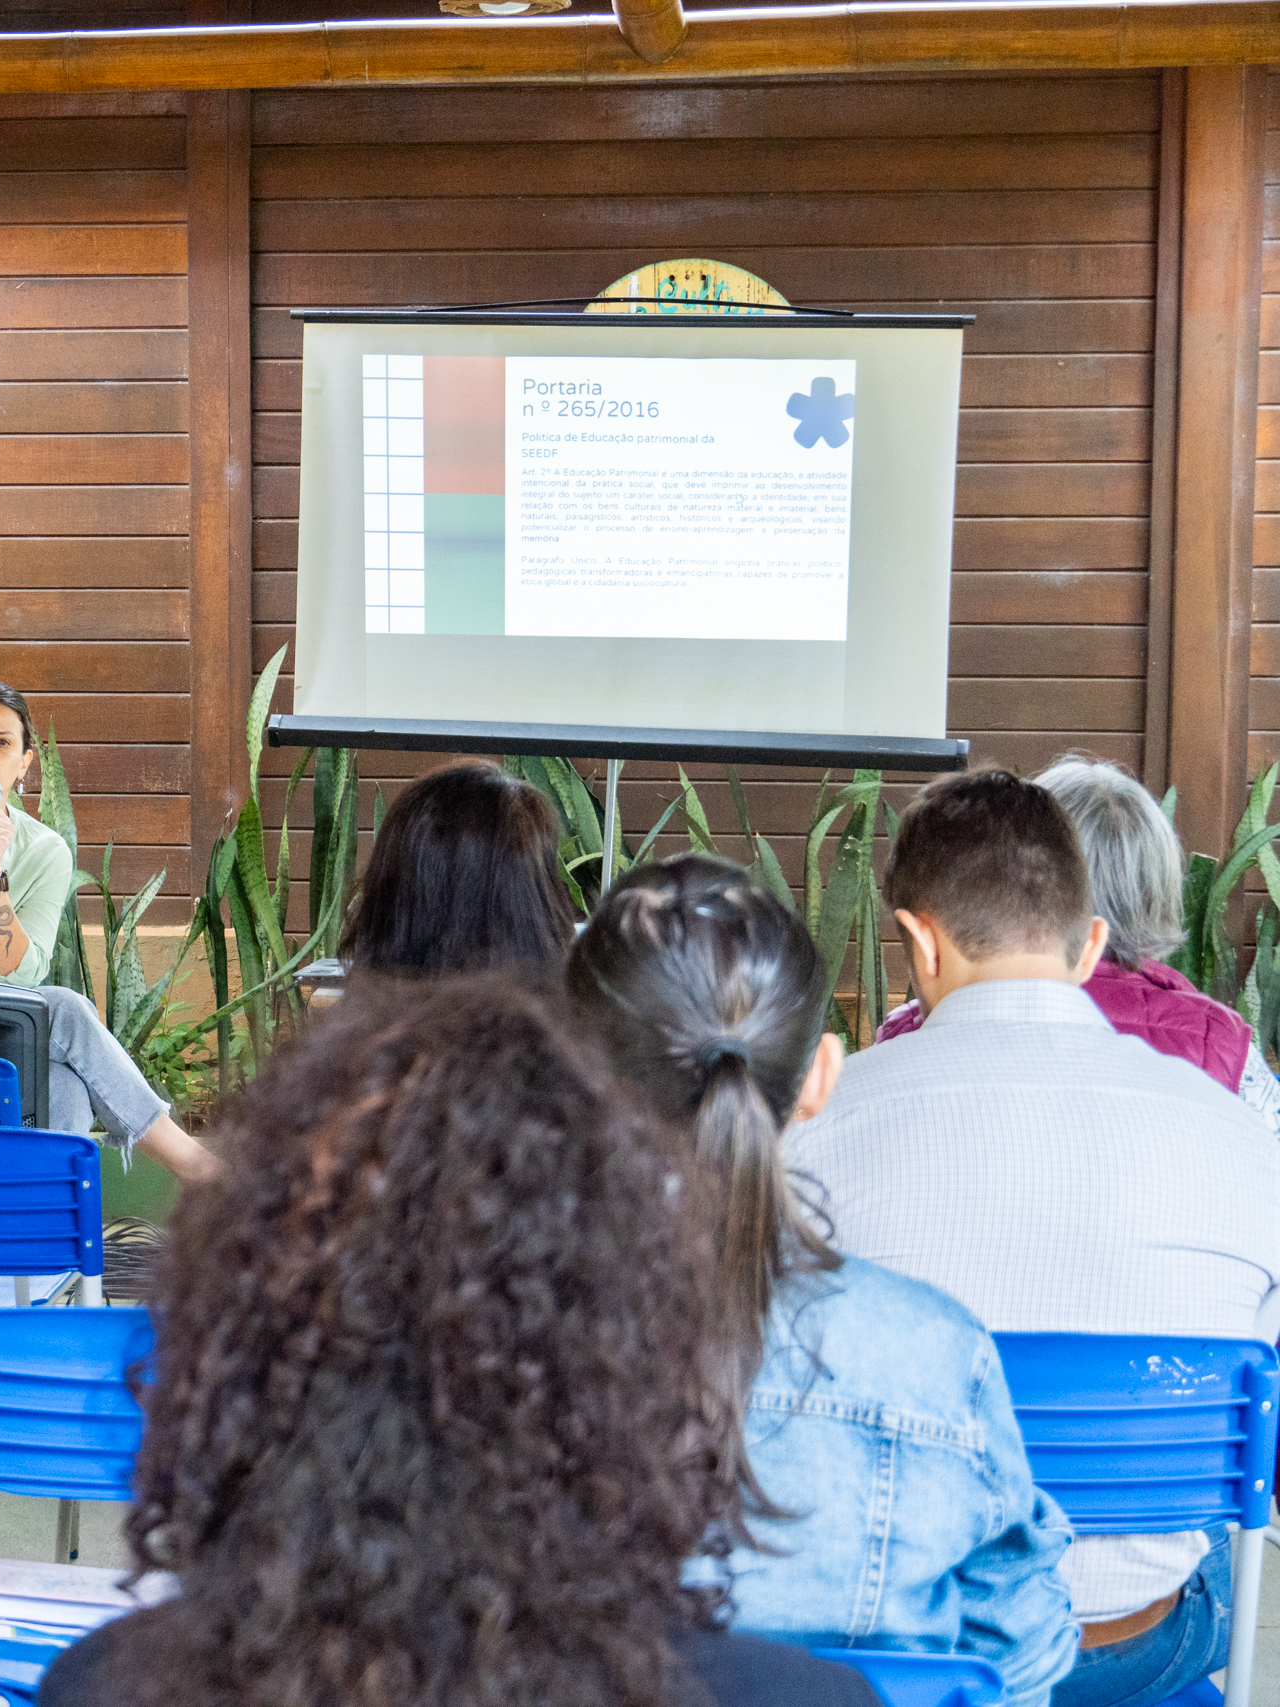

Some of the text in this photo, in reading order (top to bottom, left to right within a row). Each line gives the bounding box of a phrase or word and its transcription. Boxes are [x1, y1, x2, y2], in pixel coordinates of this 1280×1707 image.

[523, 379, 602, 395] Portaria
[523, 404, 534, 416] n
[557, 400, 659, 418] 265/2016
[564, 433, 577, 442] de
[581, 433, 633, 444] Educação
[637, 434, 698, 444] patrimonial
[701, 435, 715, 443] da
[522, 449, 557, 457] SEEDF
[563, 469, 606, 478] Educação
[692, 470, 734, 478] dimensão
[751, 472, 796, 480] educação,
[593, 480, 622, 489] prática
[772, 482, 846, 490] desenvolvimento
[521, 491, 554, 500] integral
[573, 491, 602, 500] sujeito
[658, 492, 685, 500] social,
[521, 502, 553, 511] relação
[679, 514, 721, 522] históricos
[521, 524, 576, 532] potencializar
[596, 525, 635, 533] processo
[774, 527, 827, 536] preservação
[521, 555, 564, 565] Parágrafo
[619, 557, 661, 566] Educação
[668, 558, 718, 566] Patrimonial
[724, 559, 760, 568] engloba
[521, 567, 576, 577] pedagógicas
[581, 568, 653, 576] transformadoras
[544, 579, 571, 587] global
